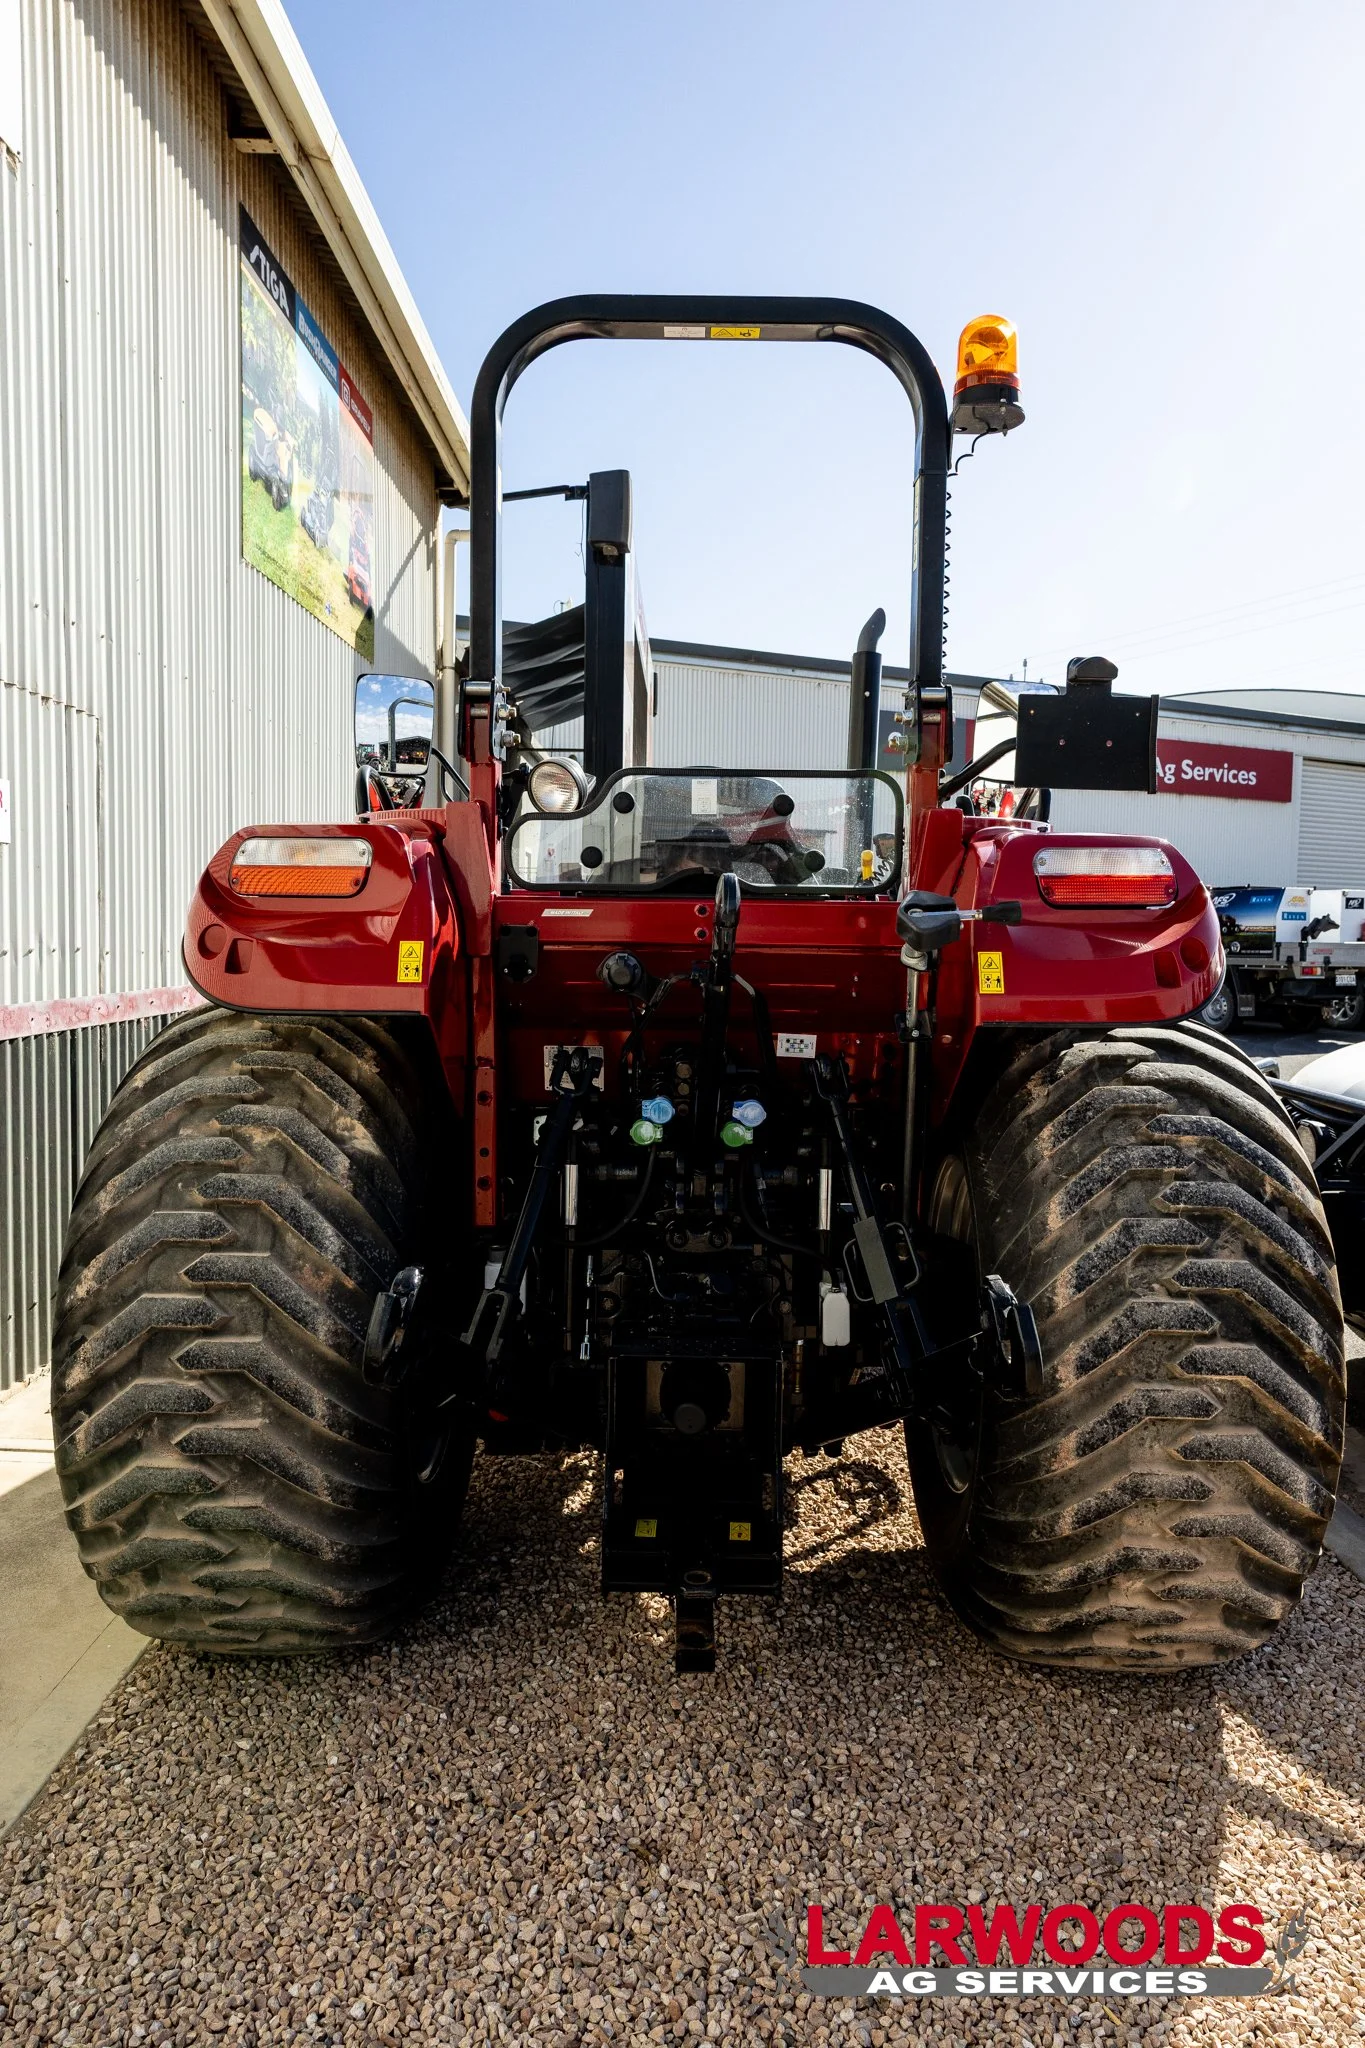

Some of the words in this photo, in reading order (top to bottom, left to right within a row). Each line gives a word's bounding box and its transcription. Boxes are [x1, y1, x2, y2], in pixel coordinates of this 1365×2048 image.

[250, 244, 290, 318] STIGA
[1156, 757, 1176, 785] Ag
[1181, 759, 1257, 785] Services
